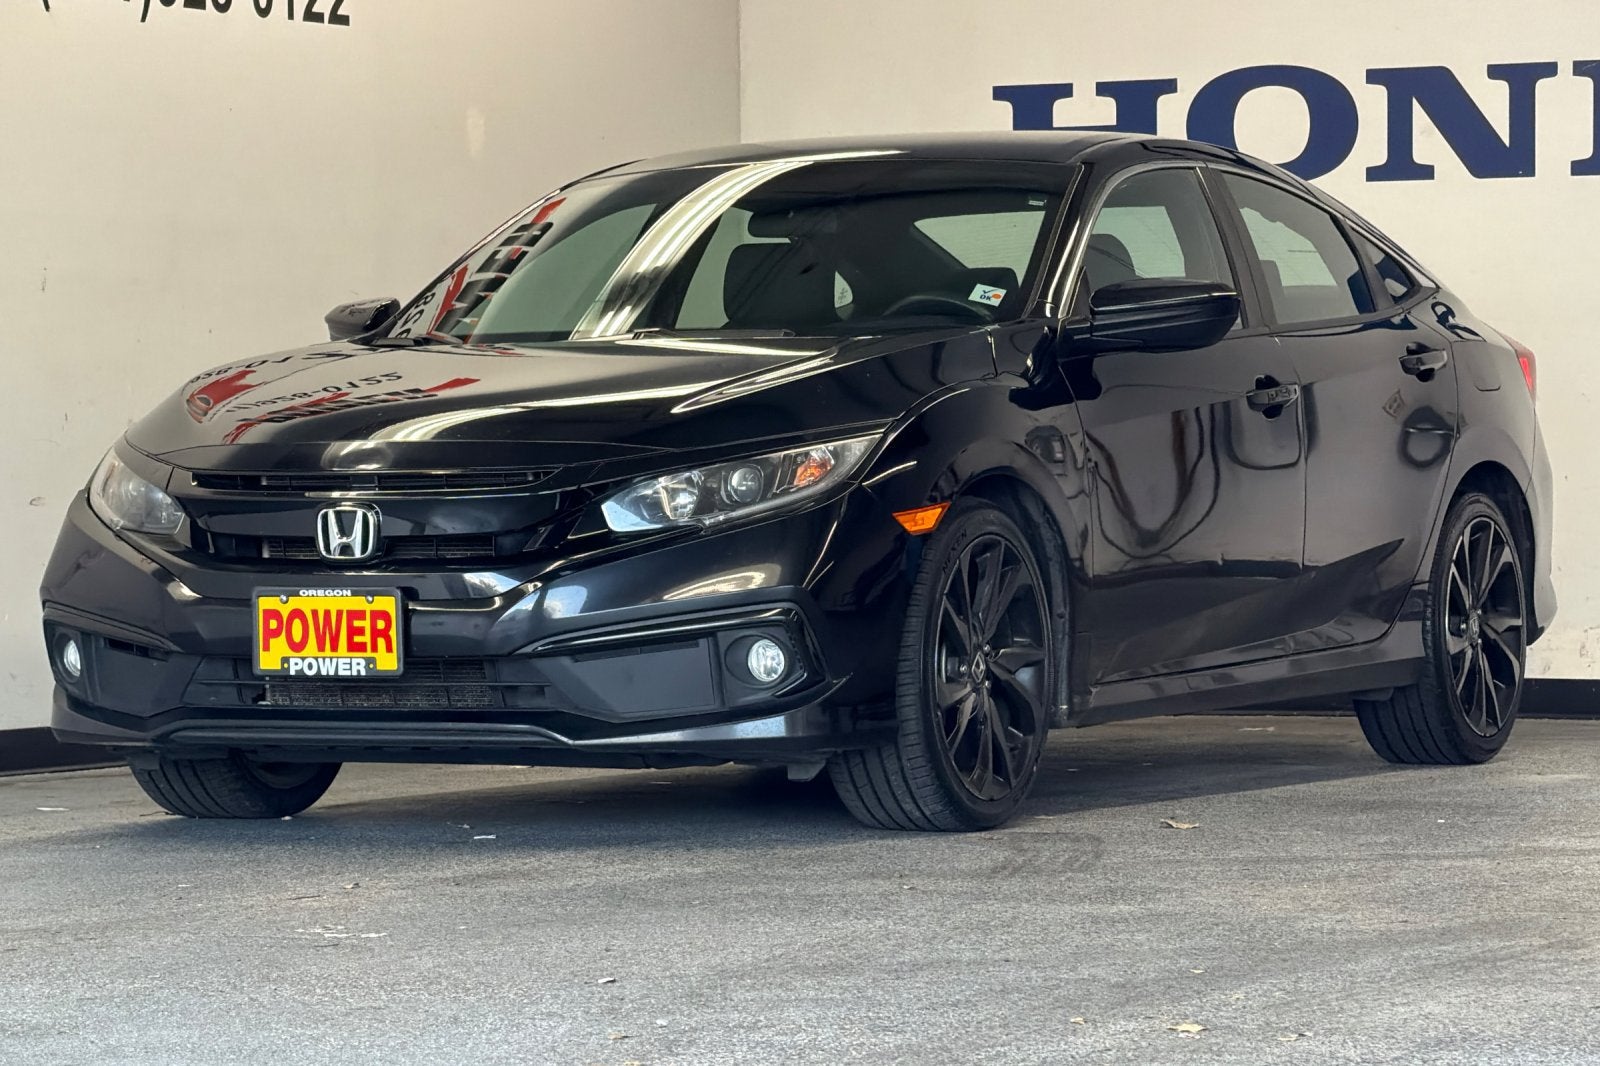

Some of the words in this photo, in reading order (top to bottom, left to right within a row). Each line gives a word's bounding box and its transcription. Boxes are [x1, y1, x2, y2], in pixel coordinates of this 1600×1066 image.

[299, 589, 351, 597] OREGON
[262, 608, 393, 653] POWER
[289, 657, 366, 676] POWER
